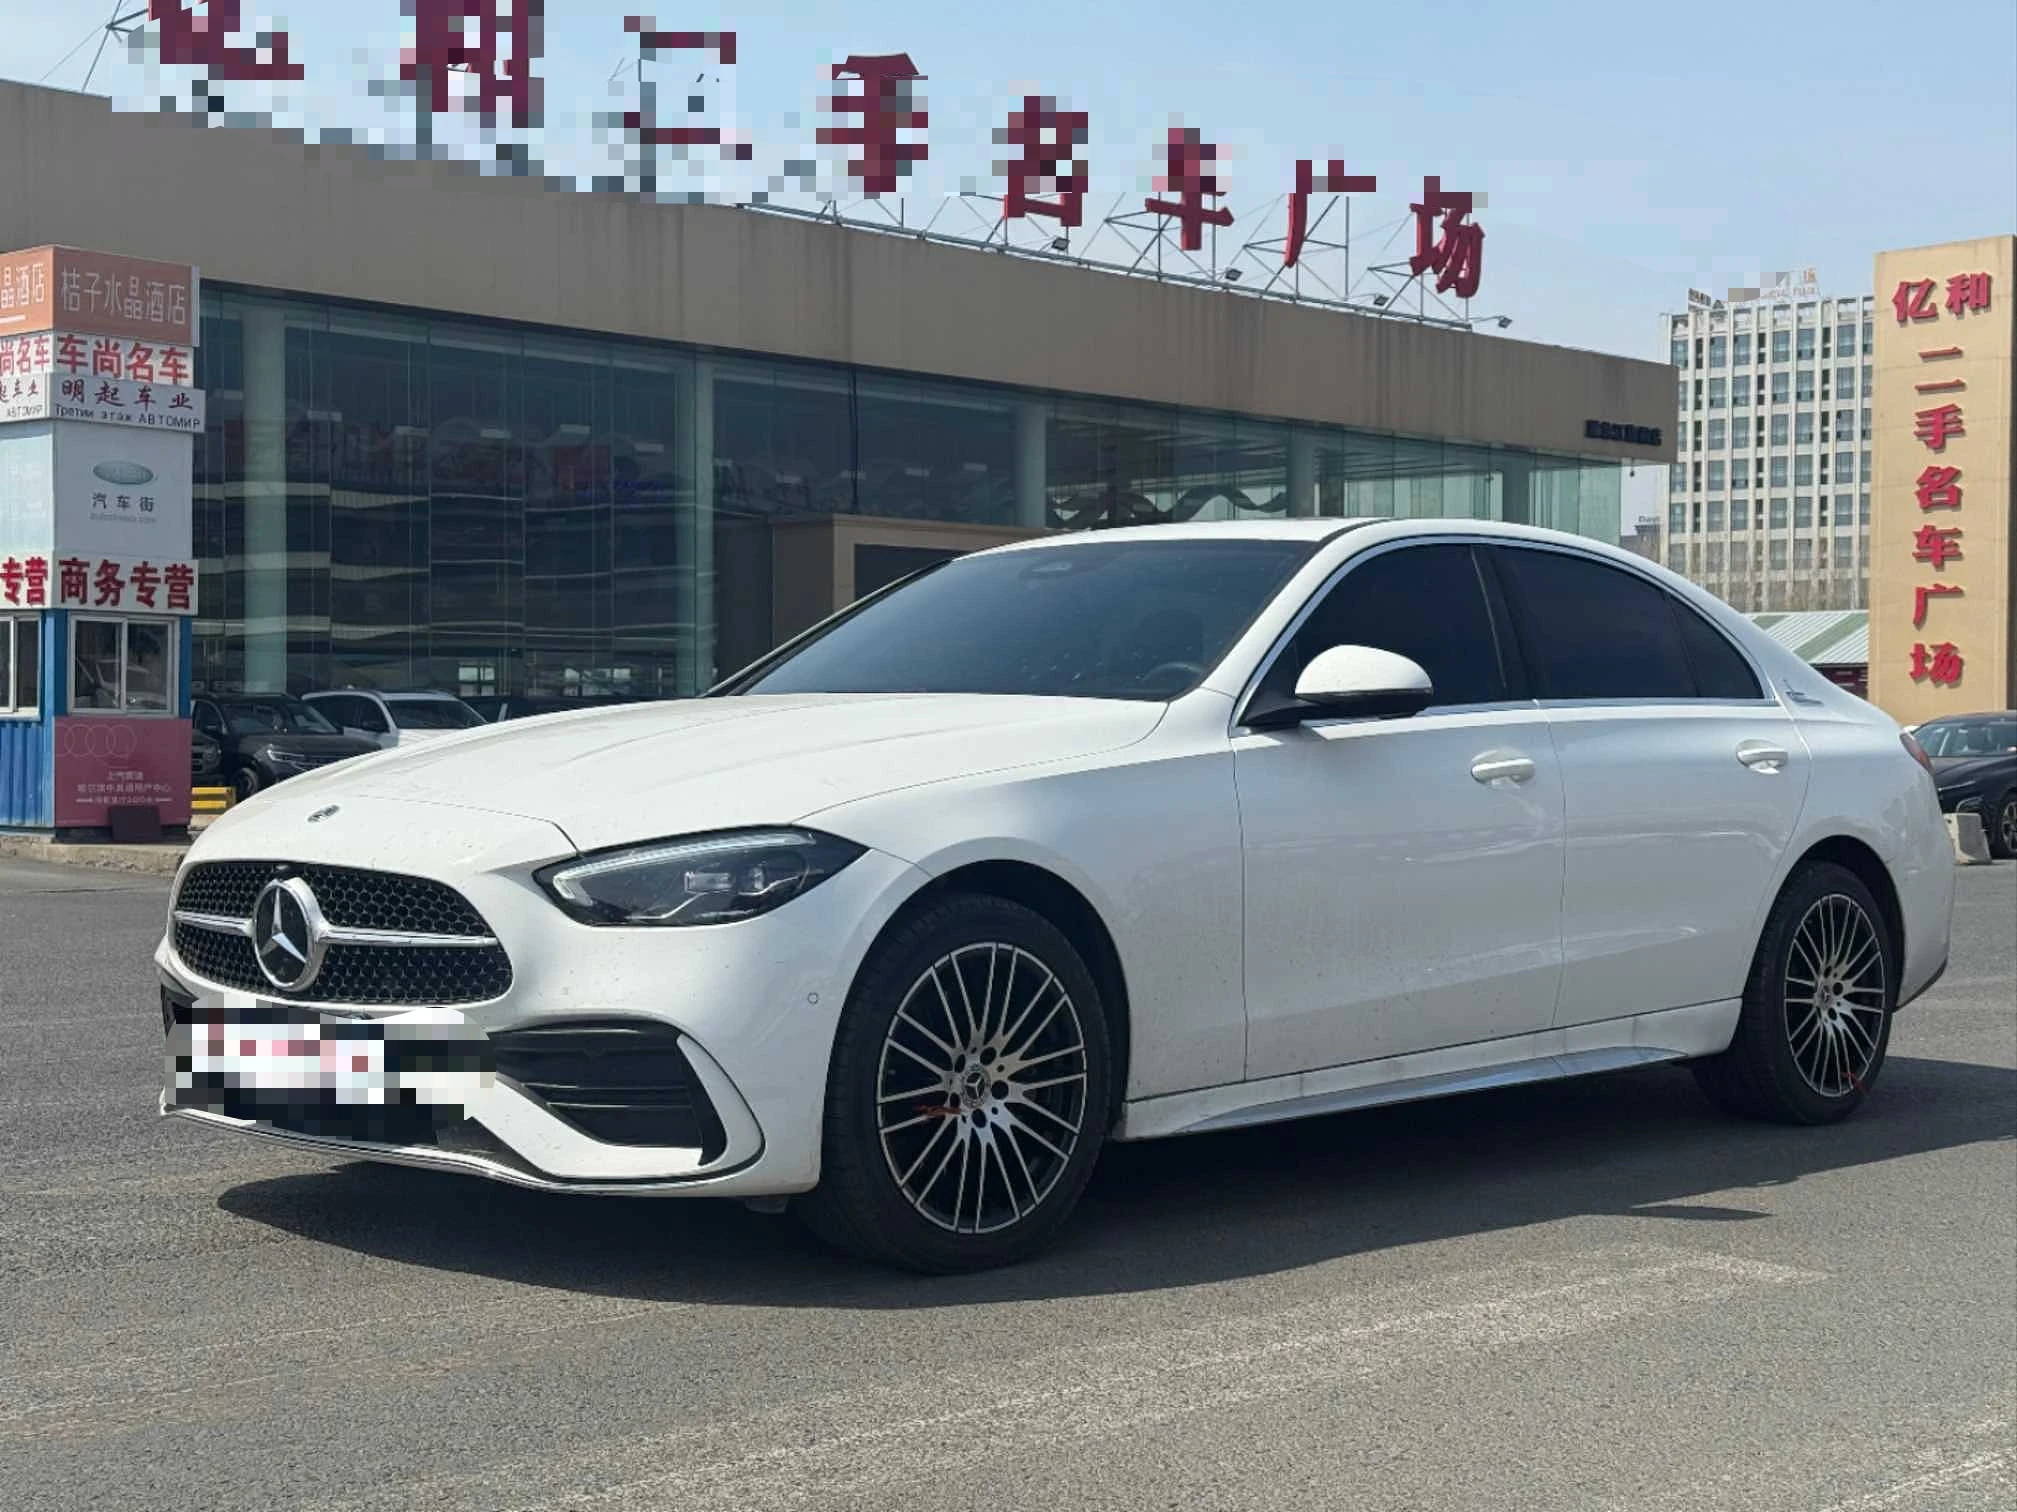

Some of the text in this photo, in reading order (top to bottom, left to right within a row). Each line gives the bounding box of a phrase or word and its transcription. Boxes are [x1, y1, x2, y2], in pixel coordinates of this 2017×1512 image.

[61, 264, 187, 325] 桔子水晶酒店
[1892, 272, 1991, 322] 亿和
[56, 334, 189, 385] 车尚名车
[61, 378, 193, 412] 明起车业
[138, 412, 201, 429] АВТОМИР
[92, 492, 154, 512] 汽车街
[1909, 345, 1966, 687] 二手名车广场
[0, 557, 48, 607] 专营
[58, 557, 194, 610] 商务专营
